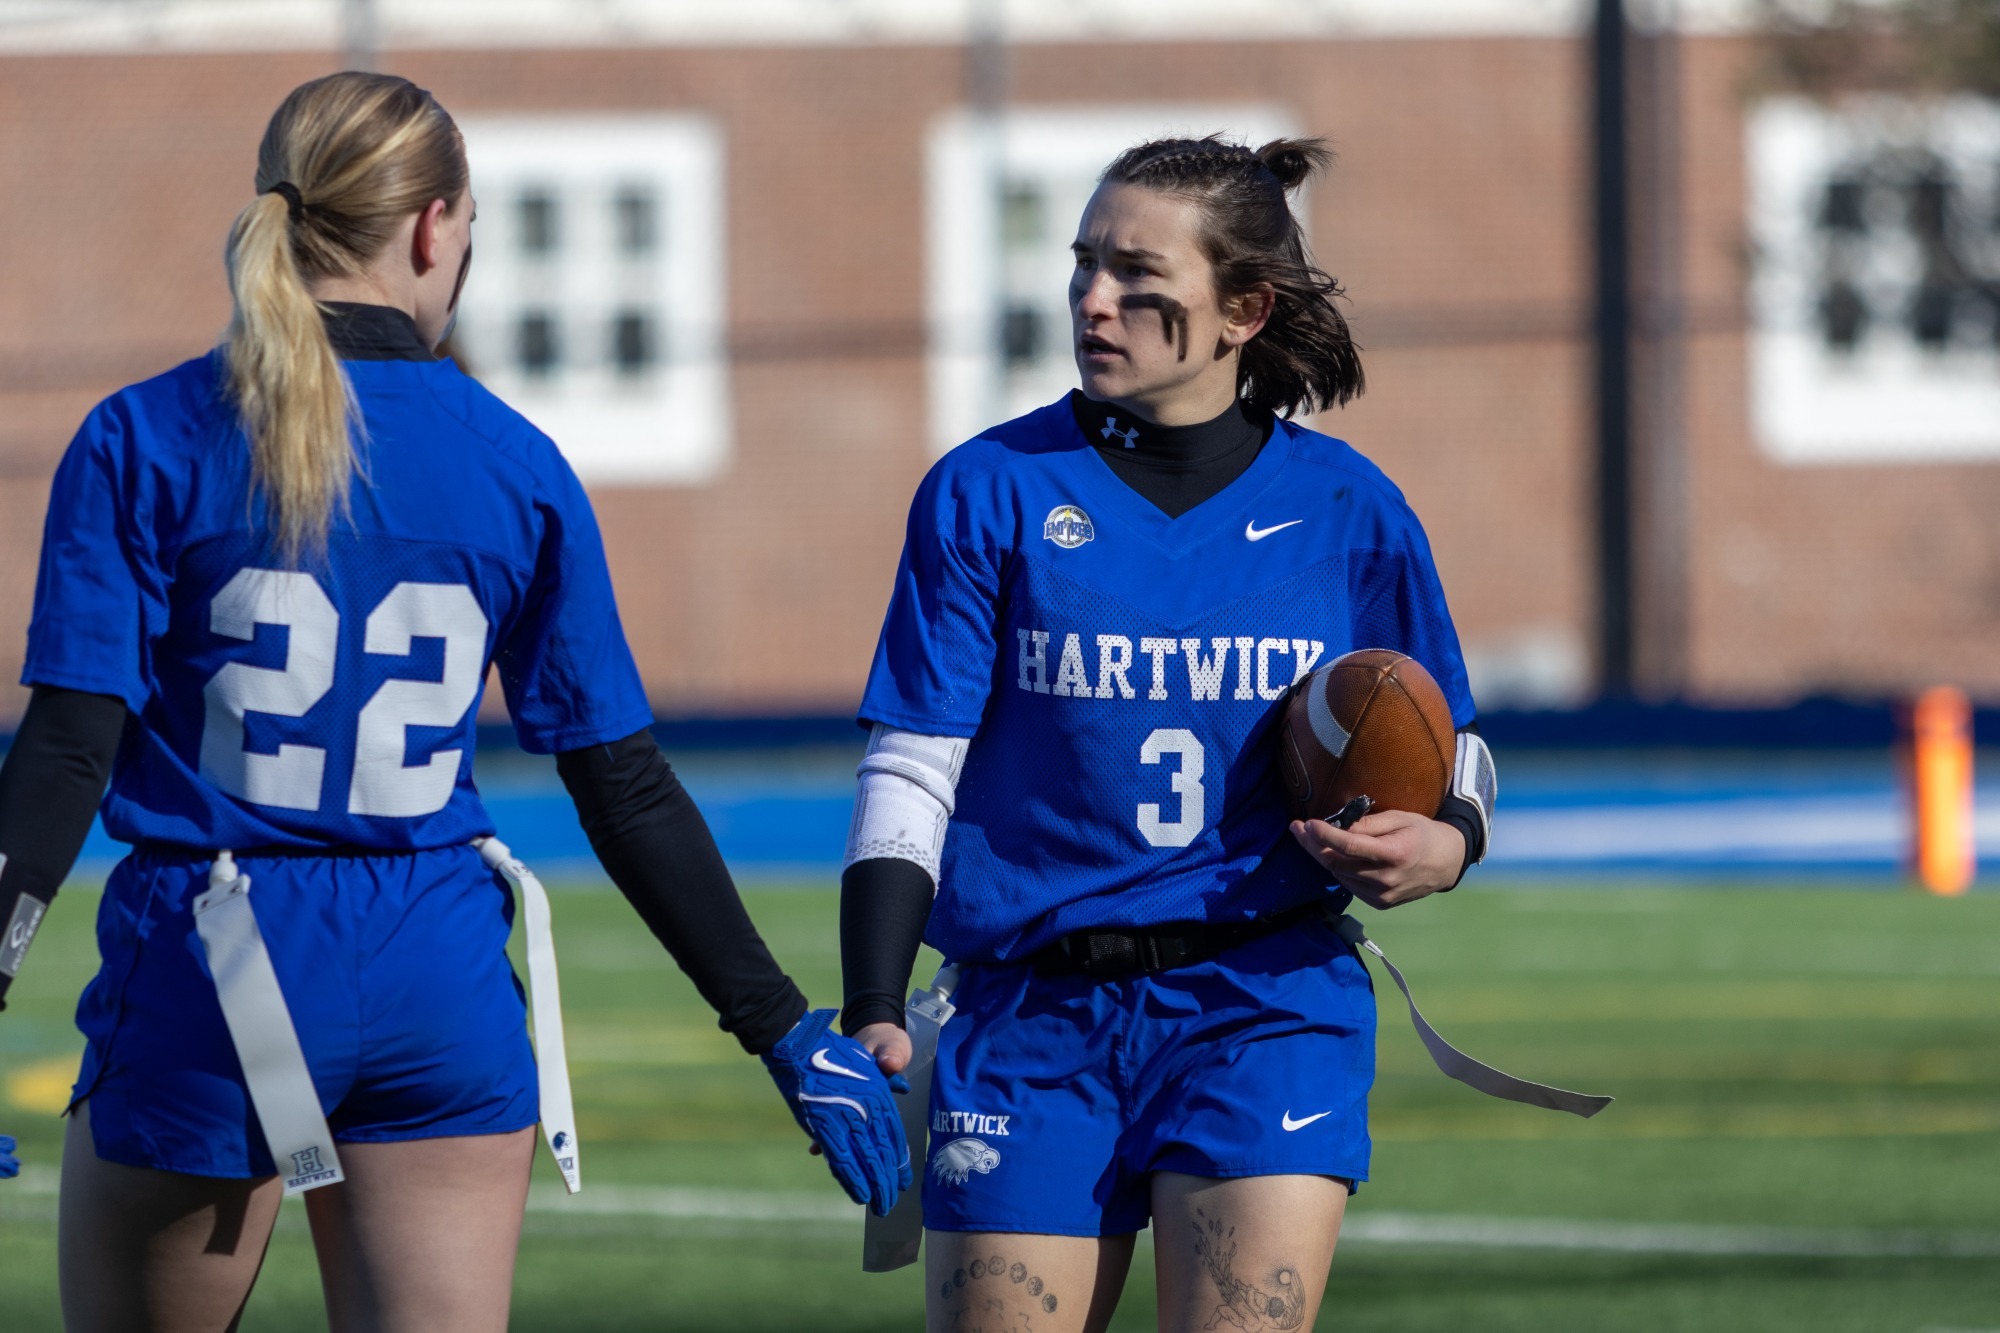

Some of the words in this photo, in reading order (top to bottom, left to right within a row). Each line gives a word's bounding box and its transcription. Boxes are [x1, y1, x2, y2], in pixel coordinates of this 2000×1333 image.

[198, 566, 490, 818] 22
[1137, 728, 1205, 848] 3
[932, 1109, 1011, 1136] ARTWICK
[290, 1145, 324, 1177] H
